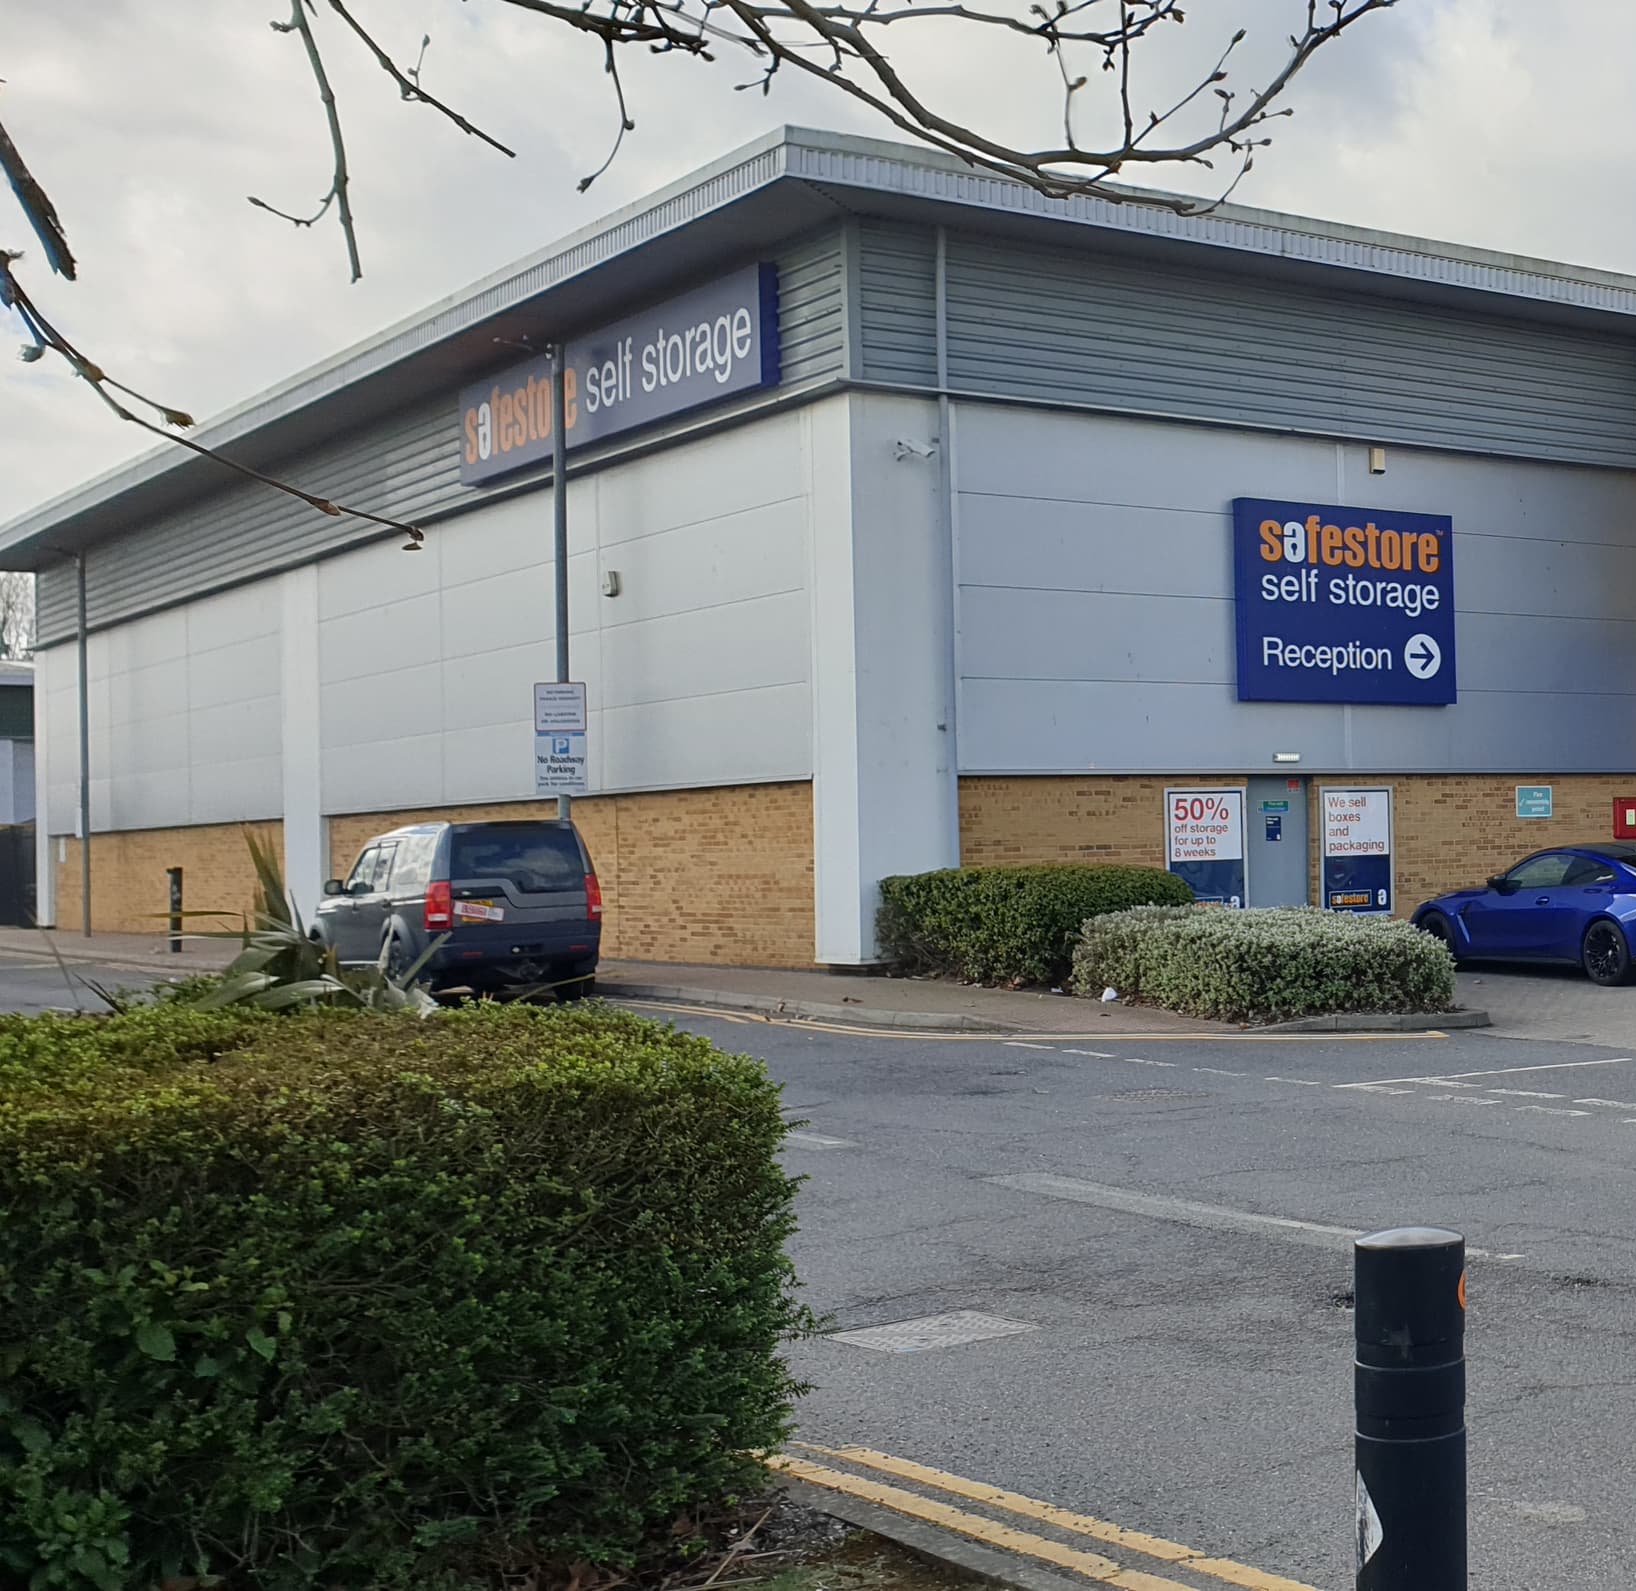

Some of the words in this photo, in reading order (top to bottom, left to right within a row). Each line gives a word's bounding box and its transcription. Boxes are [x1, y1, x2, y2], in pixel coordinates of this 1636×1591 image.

[464, 366, 577, 465] safestoe
[586, 337, 632, 413] self
[641, 307, 751, 393] storage
[1258, 514, 1440, 573] safestore
[1261, 568, 1319, 603] self
[1329, 573, 1440, 618] storage
[1262, 636, 1393, 676] Reception
[537, 755, 548, 764] No
[546, 764, 576, 776] Parking
[1174, 796, 1229, 821] 50%
[1328, 796, 1345, 808] We
[1348, 796, 1367, 808] sell
[1328, 811, 1361, 822] boxes
[1174, 823, 1188, 834] off
[1190, 823, 1229, 835] storage
[1328, 825, 1349, 837] and
[1174, 835, 1188, 846] for
[1191, 836, 1204, 848] up
[1206, 835, 1216, 845] to
[1328, 838, 1385, 854] packaging
[1184, 847, 1217, 857] weeks
[1331, 893, 1369, 906] safestore
